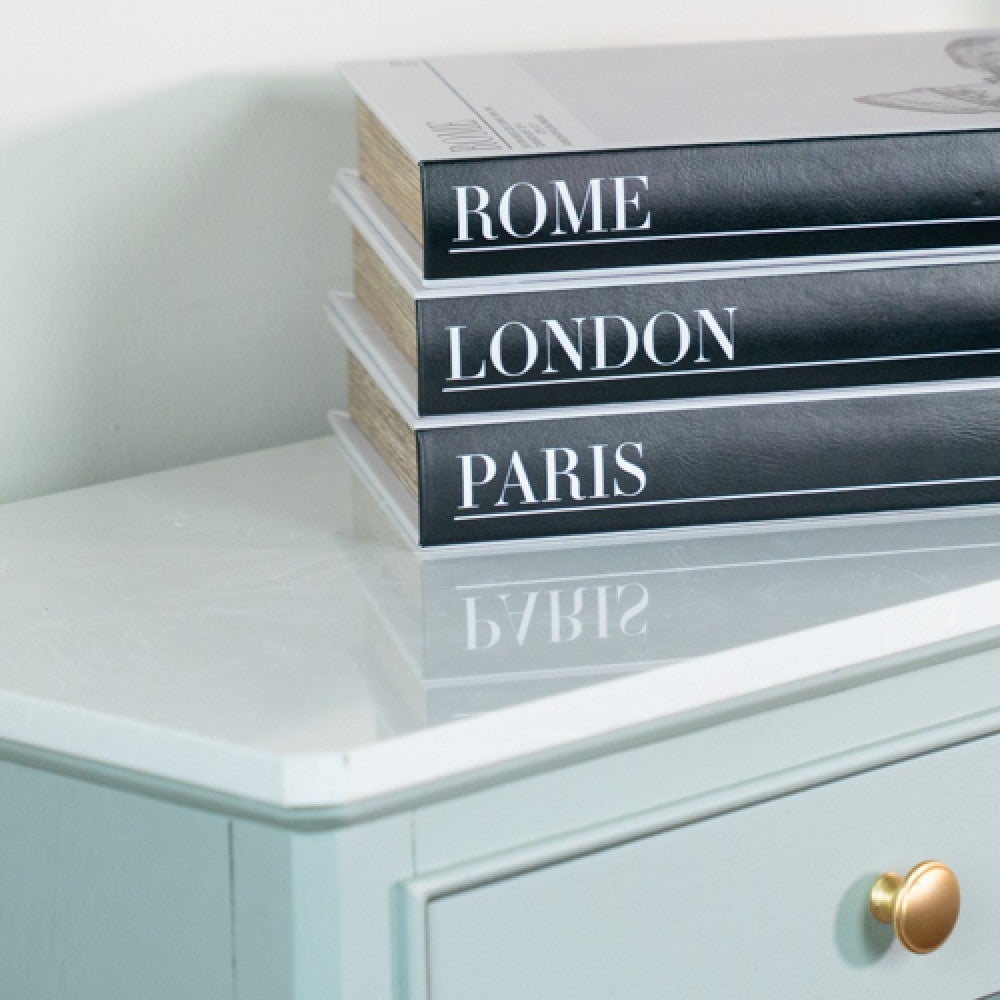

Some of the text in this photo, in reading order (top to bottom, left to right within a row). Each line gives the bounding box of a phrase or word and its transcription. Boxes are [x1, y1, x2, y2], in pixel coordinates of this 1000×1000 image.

[452, 176, 651, 242] ROME
[445, 306, 738, 381] LONDON
[456, 442, 647, 510] PARIS
